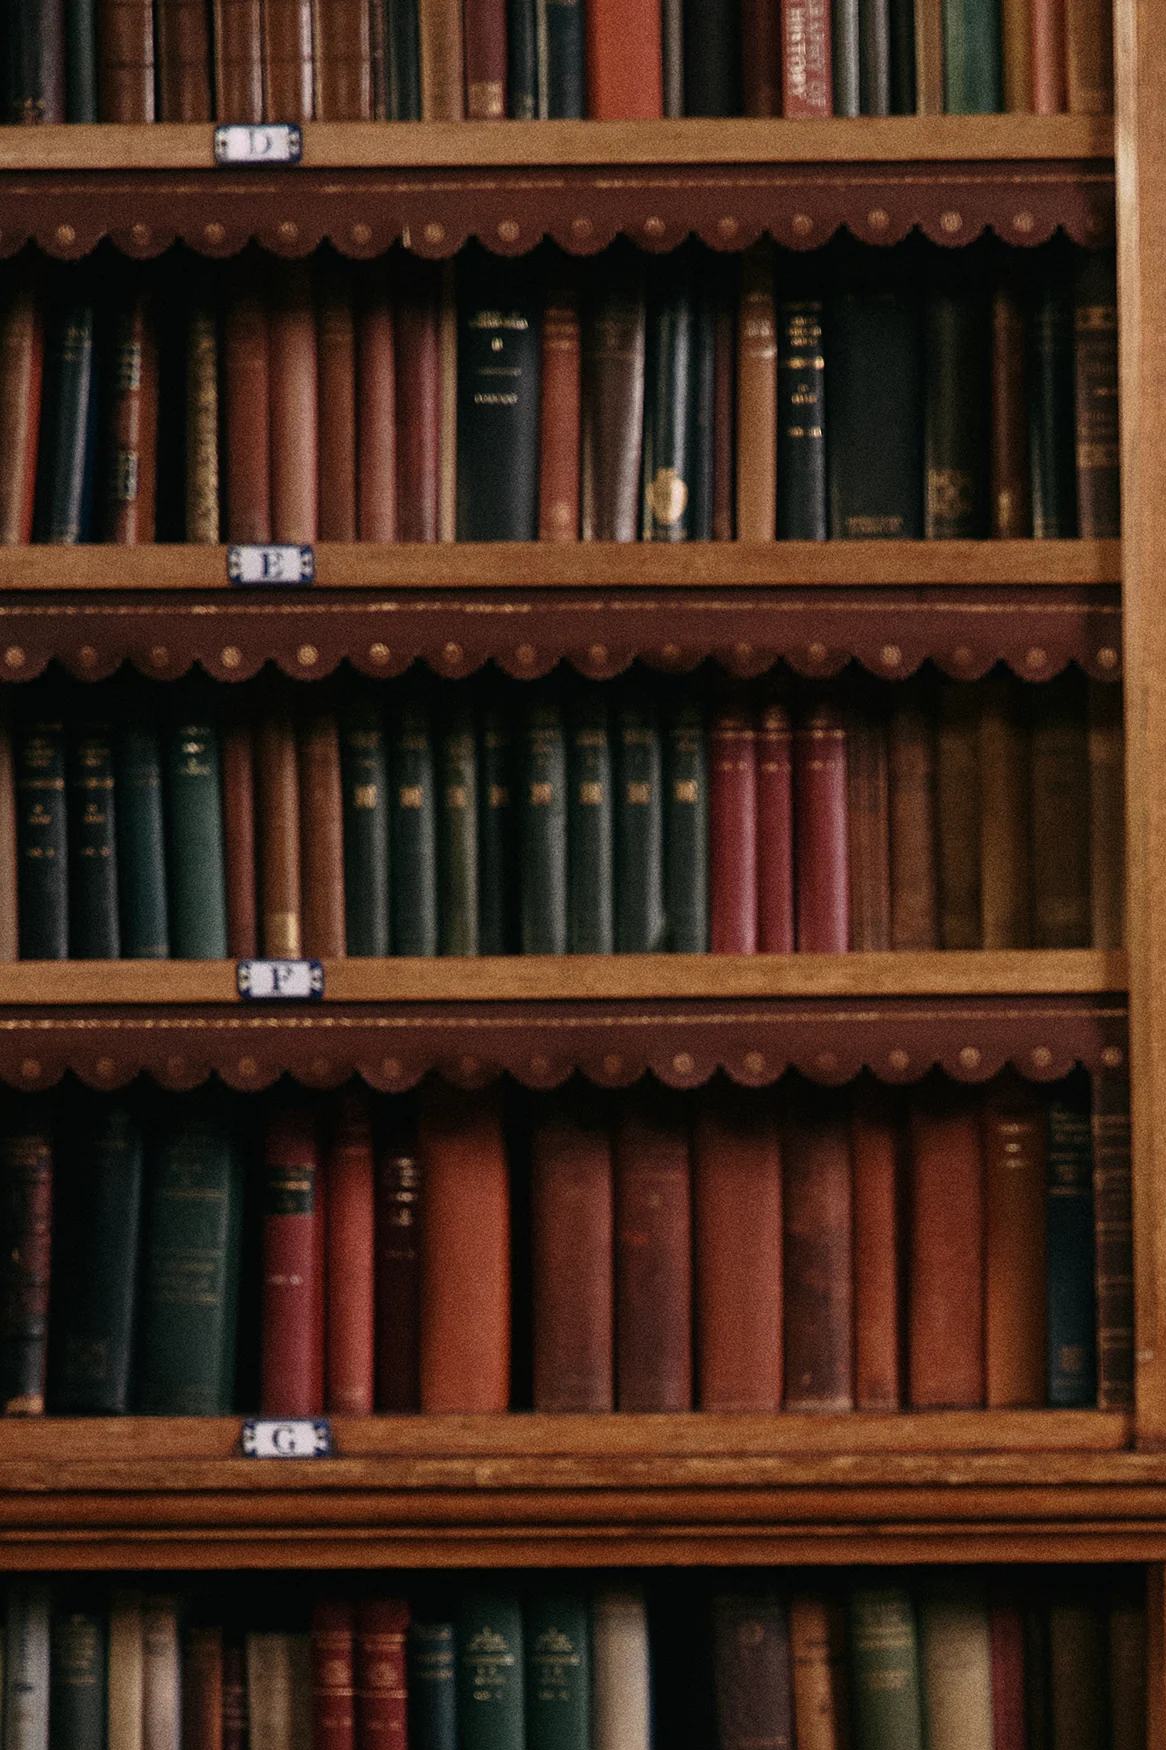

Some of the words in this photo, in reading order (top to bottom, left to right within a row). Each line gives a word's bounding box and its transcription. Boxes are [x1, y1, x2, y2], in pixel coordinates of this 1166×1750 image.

[248, 128, 272, 155] D
[260, 552, 283, 579] E
[272, 1425, 296, 1454] G
